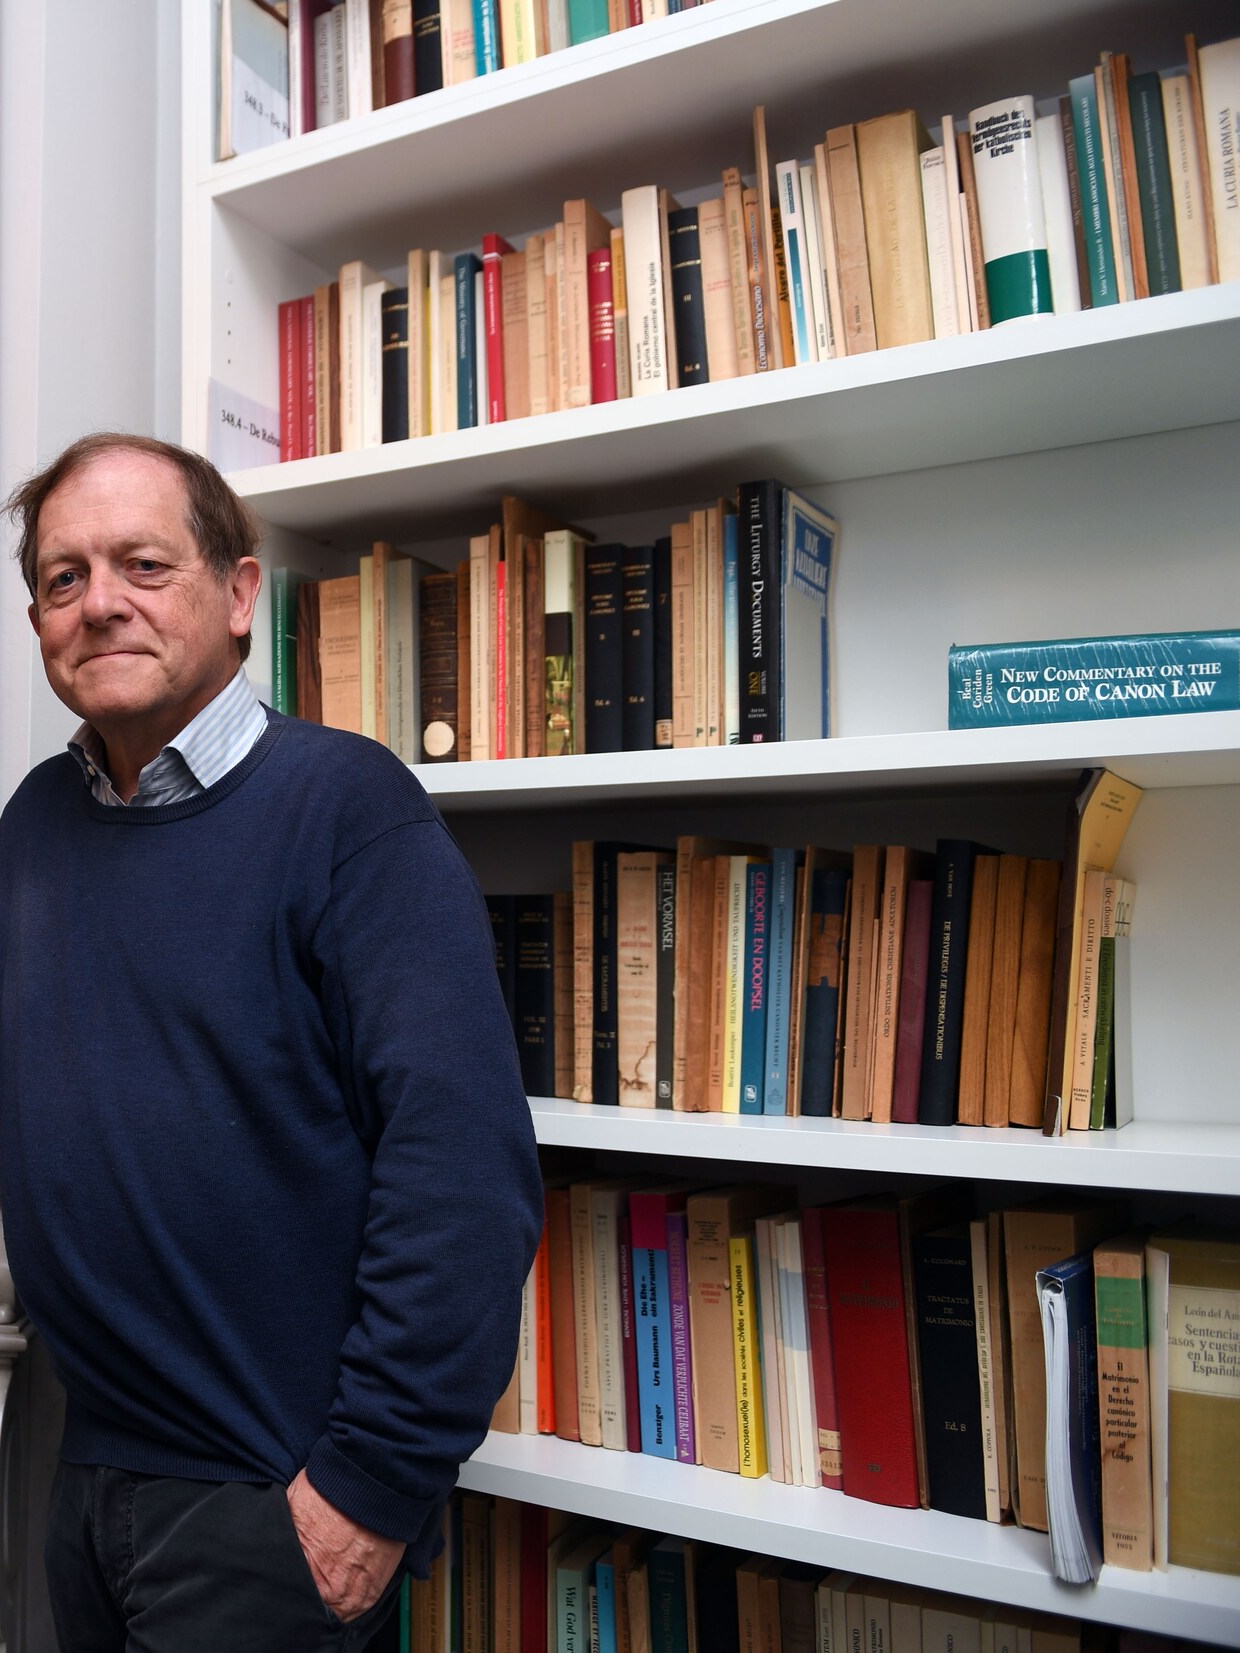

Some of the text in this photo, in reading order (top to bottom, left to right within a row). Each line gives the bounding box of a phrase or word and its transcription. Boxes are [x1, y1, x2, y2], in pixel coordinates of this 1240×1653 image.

[975, 112, 1009, 131] Handbuch
[1081, 97, 1092, 126] SECOLARI
[986, 130, 1032, 148] katholischen
[991, 144, 1014, 158] Kirche
[1084, 128, 1095, 154] ISTITUTI
[1087, 155, 1096, 169] AGLI
[1219, 108, 1237, 209] LA CURIA ROMANA
[1088, 170, 1100, 202] ASSOCIATI
[1092, 204, 1102, 229] MEMBRI
[648, 262, 657, 285] Iglesia
[459, 282, 467, 308] Ministry
[650, 296, 658, 305] de
[650, 307, 659, 332] central
[754, 286, 765, 329] Diocesano
[459, 320, 467, 359] Governance
[642, 315, 652, 378] La Curia Romana
[651, 335, 661, 367] gobierno
[250, 423, 260, 438] De
[750, 496, 764, 659] THE LITURGY DOCUMENTS
[748, 671, 760, 696] ONE
[1000, 662, 1221, 683] NEW COMMENTARY ON THE
[962, 677, 971, 701] Beal
[972, 668, 982, 709] Coriden
[983, 673, 993, 704] Green
[1007, 680, 1217, 704] CODE OF CANON LAW
[662, 872, 673, 952] HET VORMSEL
[1103, 888, 1114, 936] do-c dossiers
[943, 921, 952, 931] DE
[750, 872, 766, 1012] GEBOORTE EN DOOPSEL
[884, 973, 892, 1015] INITIATIONIS
[888, 886, 897, 928] ADULTORUM
[1082, 966, 1092, 1018] SACRAMENTI
[1087, 918, 1095, 952] DIRITTO
[940, 979, 948, 989] DE
[935, 990, 947, 1060] DISPENSATIONIBUS
[1097, 997, 1109, 1046] ontwikkeling
[734, 1264, 744, 1307] religieuses
[640, 1283, 648, 1317] Die Ehe
[649, 1304, 657, 1317] ein
[927, 1295, 969, 1305] TRACTATUS
[1184, 1305, 1206, 1316] León
[1208, 1309, 1221, 1318] del
[673, 1304, 684, 1330] ZONDE
[924, 1316, 974, 1327] MATRIMONIO
[674, 1330, 684, 1346] VAN
[736, 1318, 746, 1342] civiles
[651, 1326, 661, 1387] Urs Baumann
[675, 1346, 685, 1361] DAT
[1187, 1351, 1200, 1361] en
[1204, 1350, 1214, 1362] la
[1199, 1341, 1206, 1350] y
[1102, 1372, 1139, 1384] Matrimonio
[1117, 1362, 1124, 1372] El
[1192, 1361, 1240, 1377] Española
[676, 1362, 687, 1406] VERPLICHTE
[1112, 1385, 1130, 1394] en el
[1107, 1406, 1136, 1417] canónico
[1108, 1394, 1134, 1406] Derecho
[654, 1404, 664, 1444] Benziger
[678, 1406, 689, 1442] CELIBAAT
[945, 1422, 966, 1432] Ed. 8
[1106, 1418, 1138, 1430] particular
[1108, 1430, 1136, 1440] posterior
[985, 1428, 993, 1452] COPPOLA
[1119, 1442, 1126, 1450] al
[1112, 1450, 1134, 1462] Código
[566, 1587, 576, 1608] Wat
[566, 1612, 577, 1635] God
[592, 1628, 598, 1636] ET
